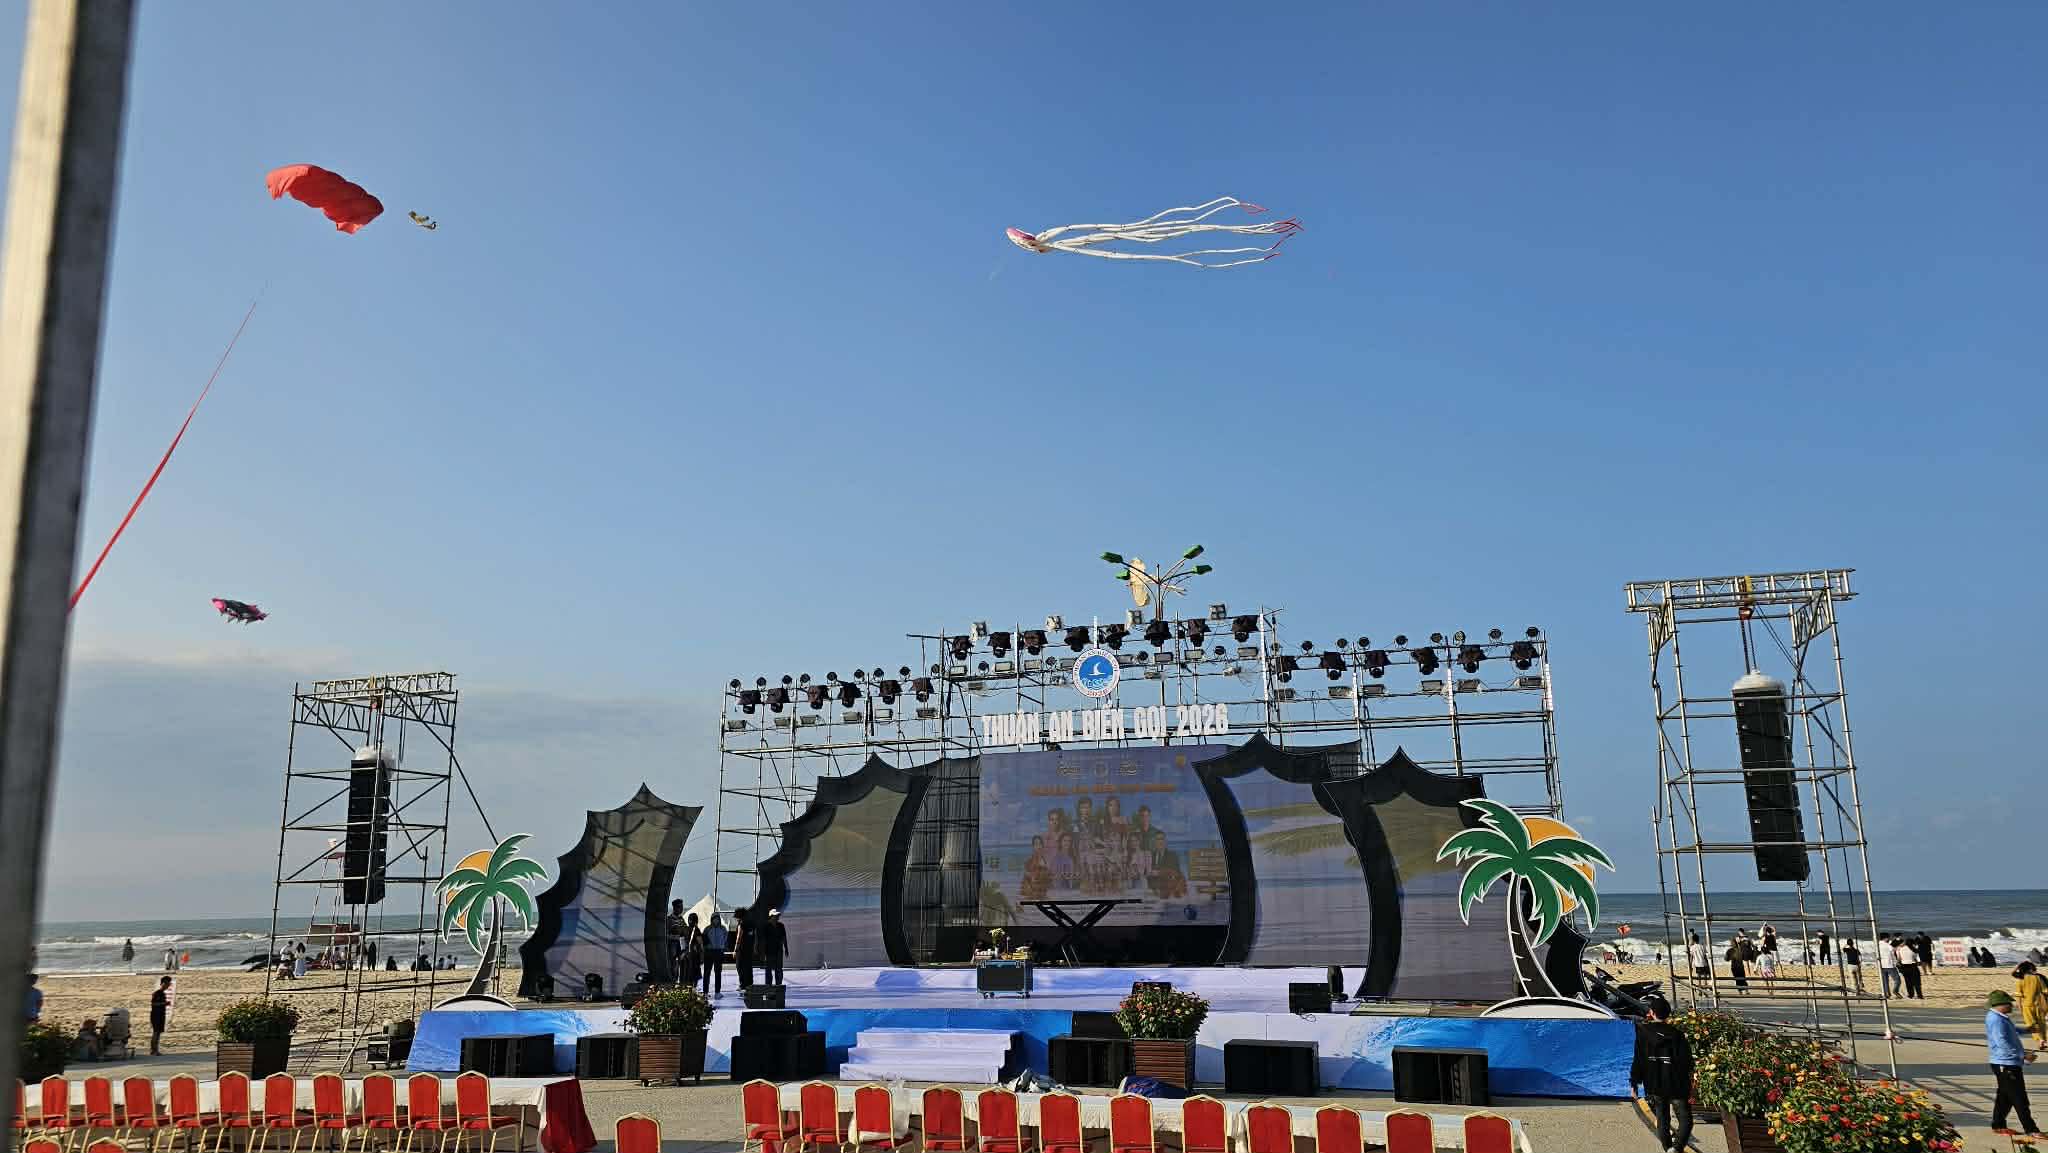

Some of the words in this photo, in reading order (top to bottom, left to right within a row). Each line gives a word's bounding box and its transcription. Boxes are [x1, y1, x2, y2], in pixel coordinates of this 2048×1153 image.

[982, 709, 1039, 748] THUẬN
[1049, 711, 1073, 742] AN
[1134, 704, 1167, 742] GỌI
[1176, 703, 1229, 737] 2026
